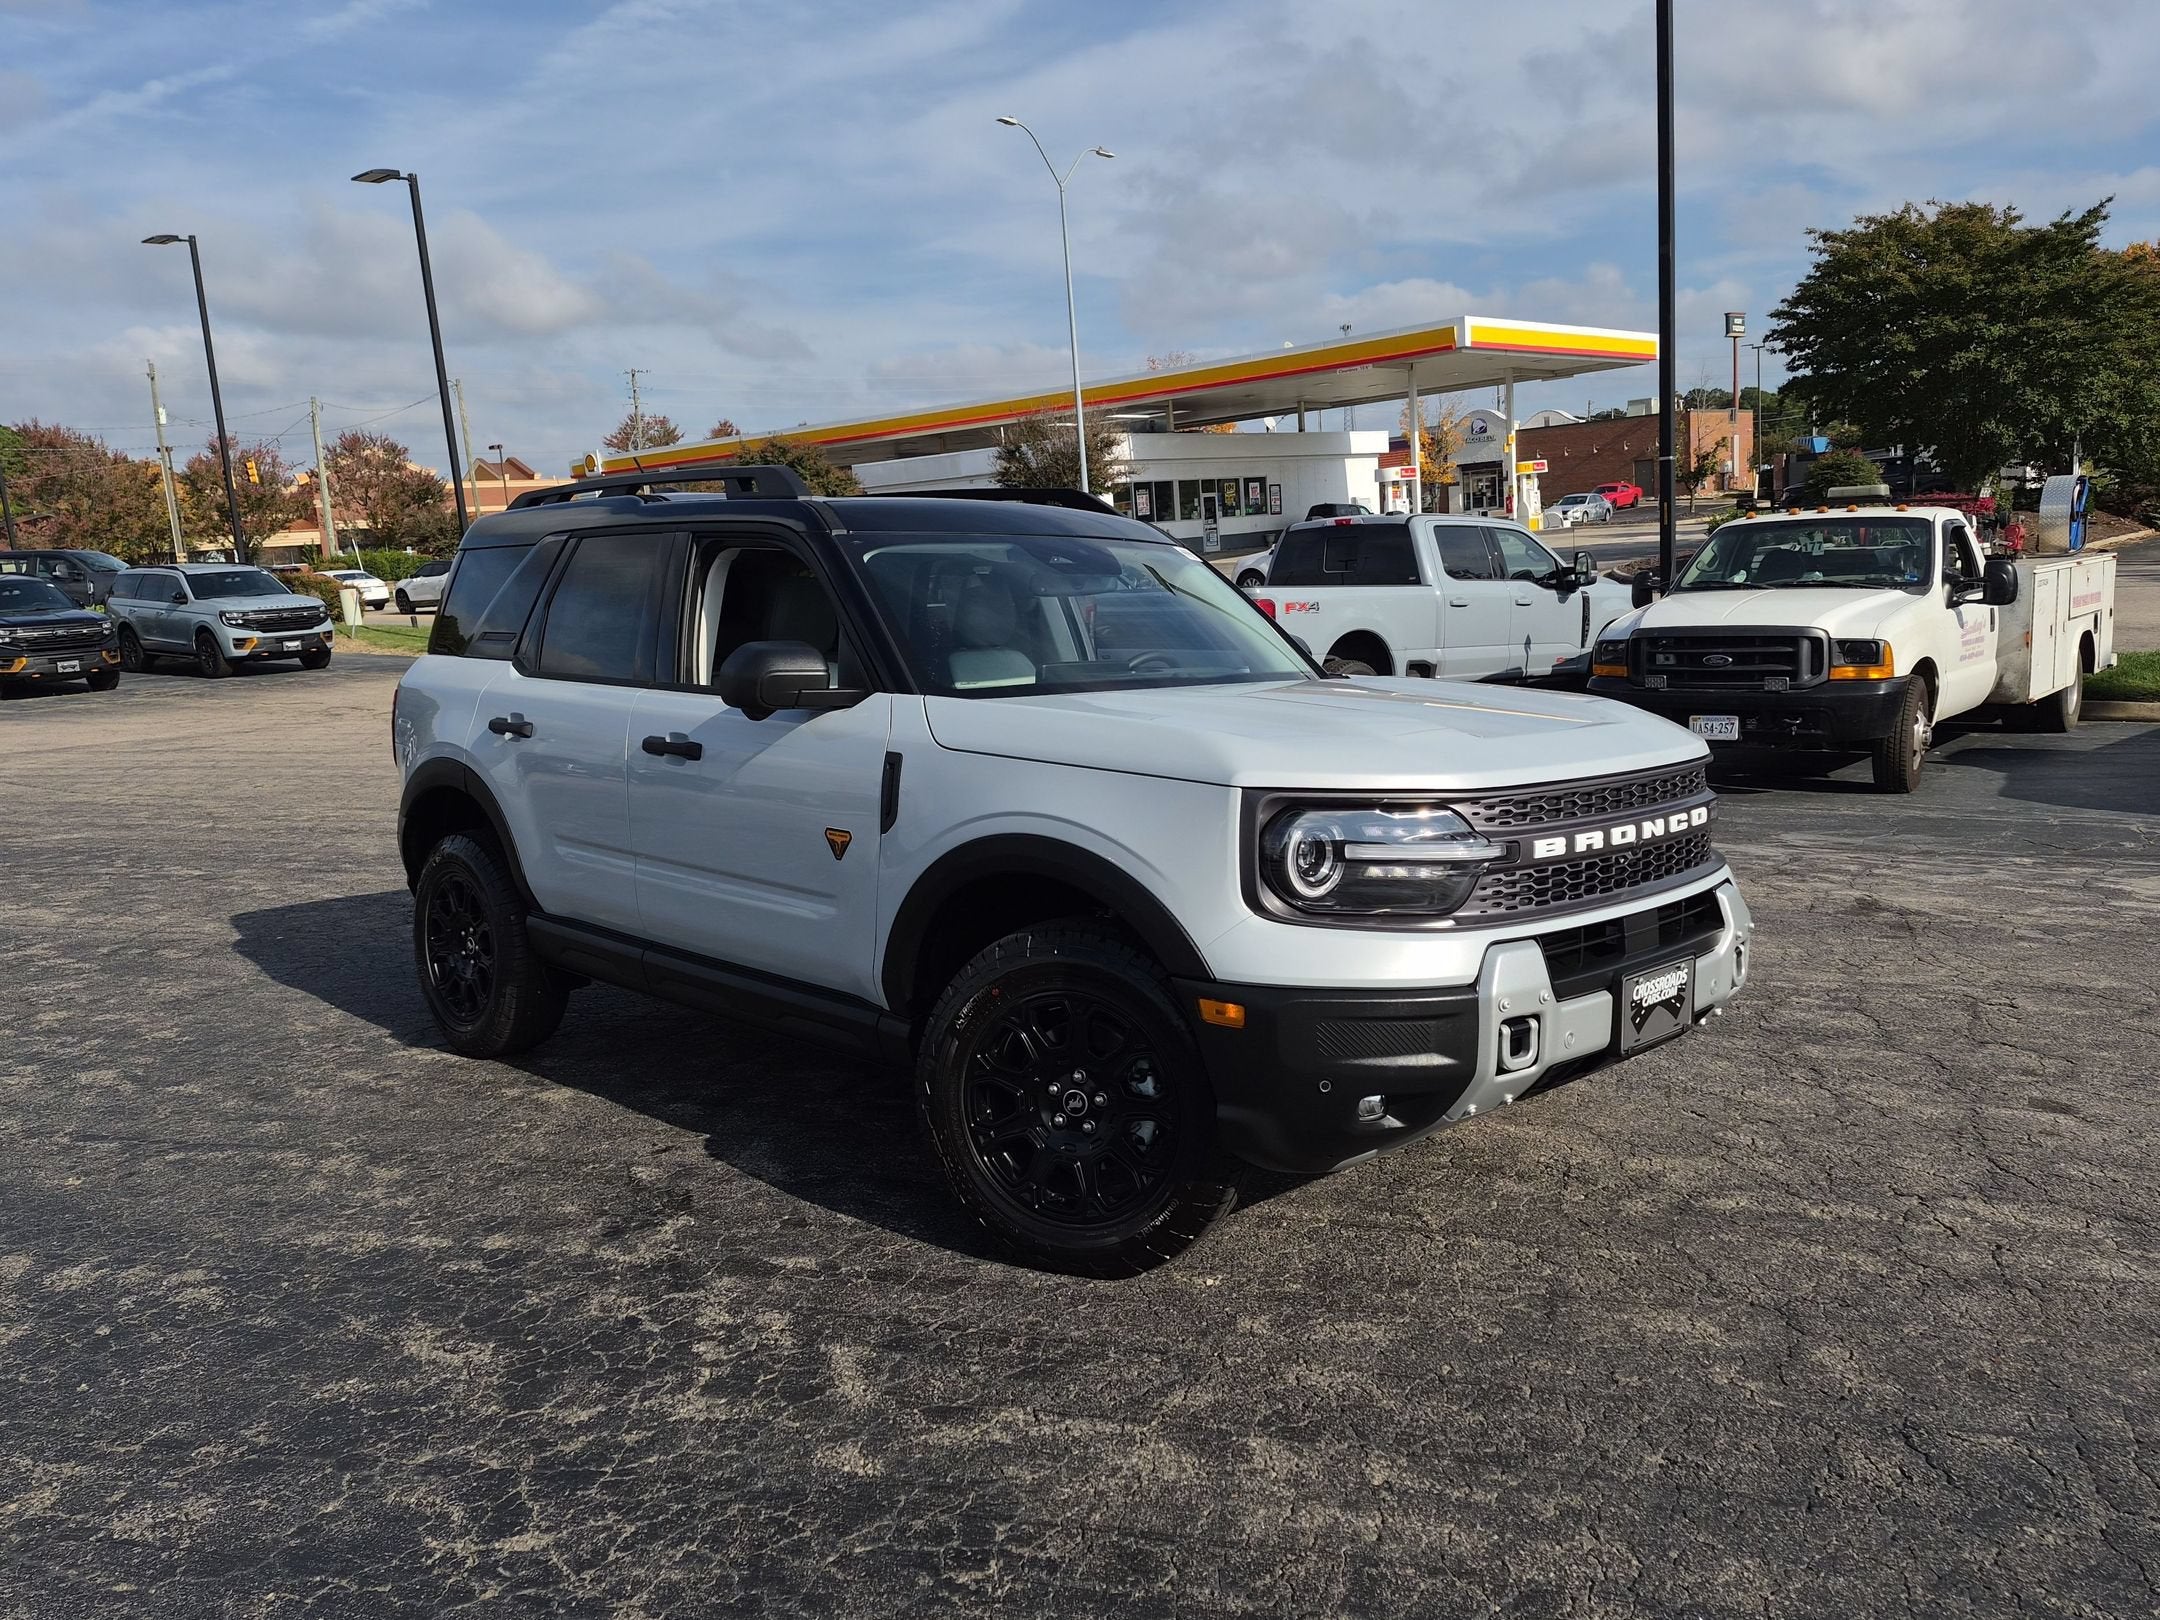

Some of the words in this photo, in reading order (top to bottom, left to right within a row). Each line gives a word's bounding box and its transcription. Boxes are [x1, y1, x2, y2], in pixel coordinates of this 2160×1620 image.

[1284, 601, 1320, 614] FX4
[1692, 722, 1736, 734] UA54-257
[1533, 806, 1708, 859] BRONCO
[1633, 968, 1689, 1001] CROSSROADS
[1642, 985, 1678, 1008] CARS.COM
